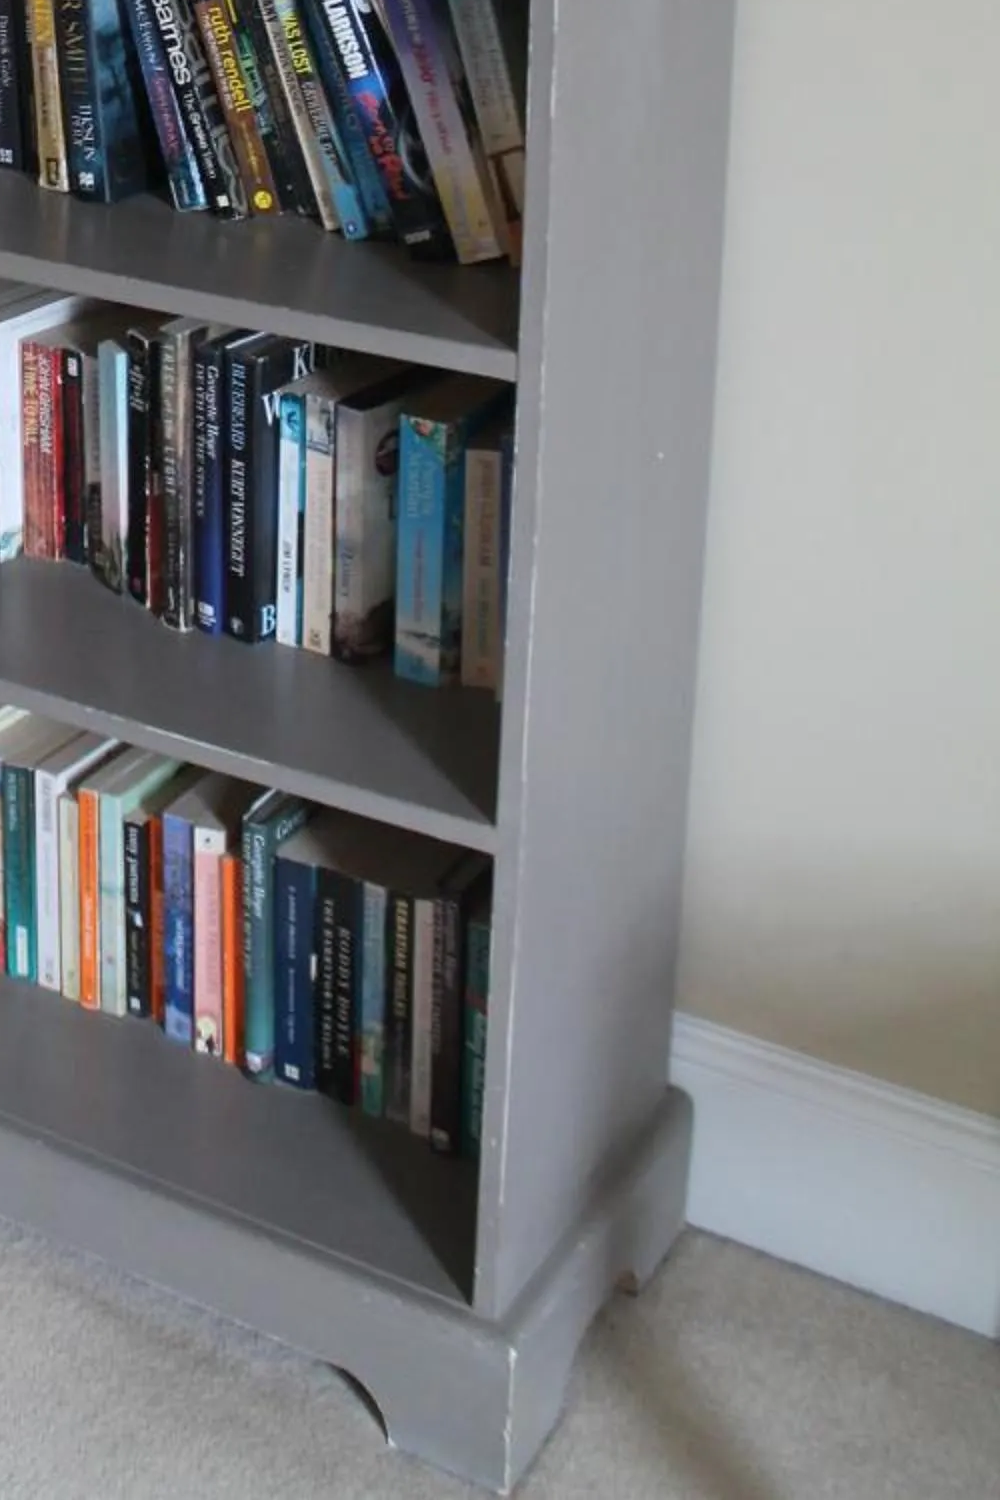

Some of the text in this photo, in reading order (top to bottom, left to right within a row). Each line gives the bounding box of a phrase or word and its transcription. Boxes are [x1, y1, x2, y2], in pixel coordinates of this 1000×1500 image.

[62, 20, 88, 97] SMITH
[209, 5, 234, 44] ruth
[222, 50, 253, 113] rendell
[290, 43, 313, 75] LOST
[39, 353, 51, 390] JOHN
[230, 362, 246, 450] BLUEBEARD
[164, 445, 176, 497] LIGHT
[230, 457, 246, 500] KURT
[394, 899, 408, 969] SEBASTIAN
